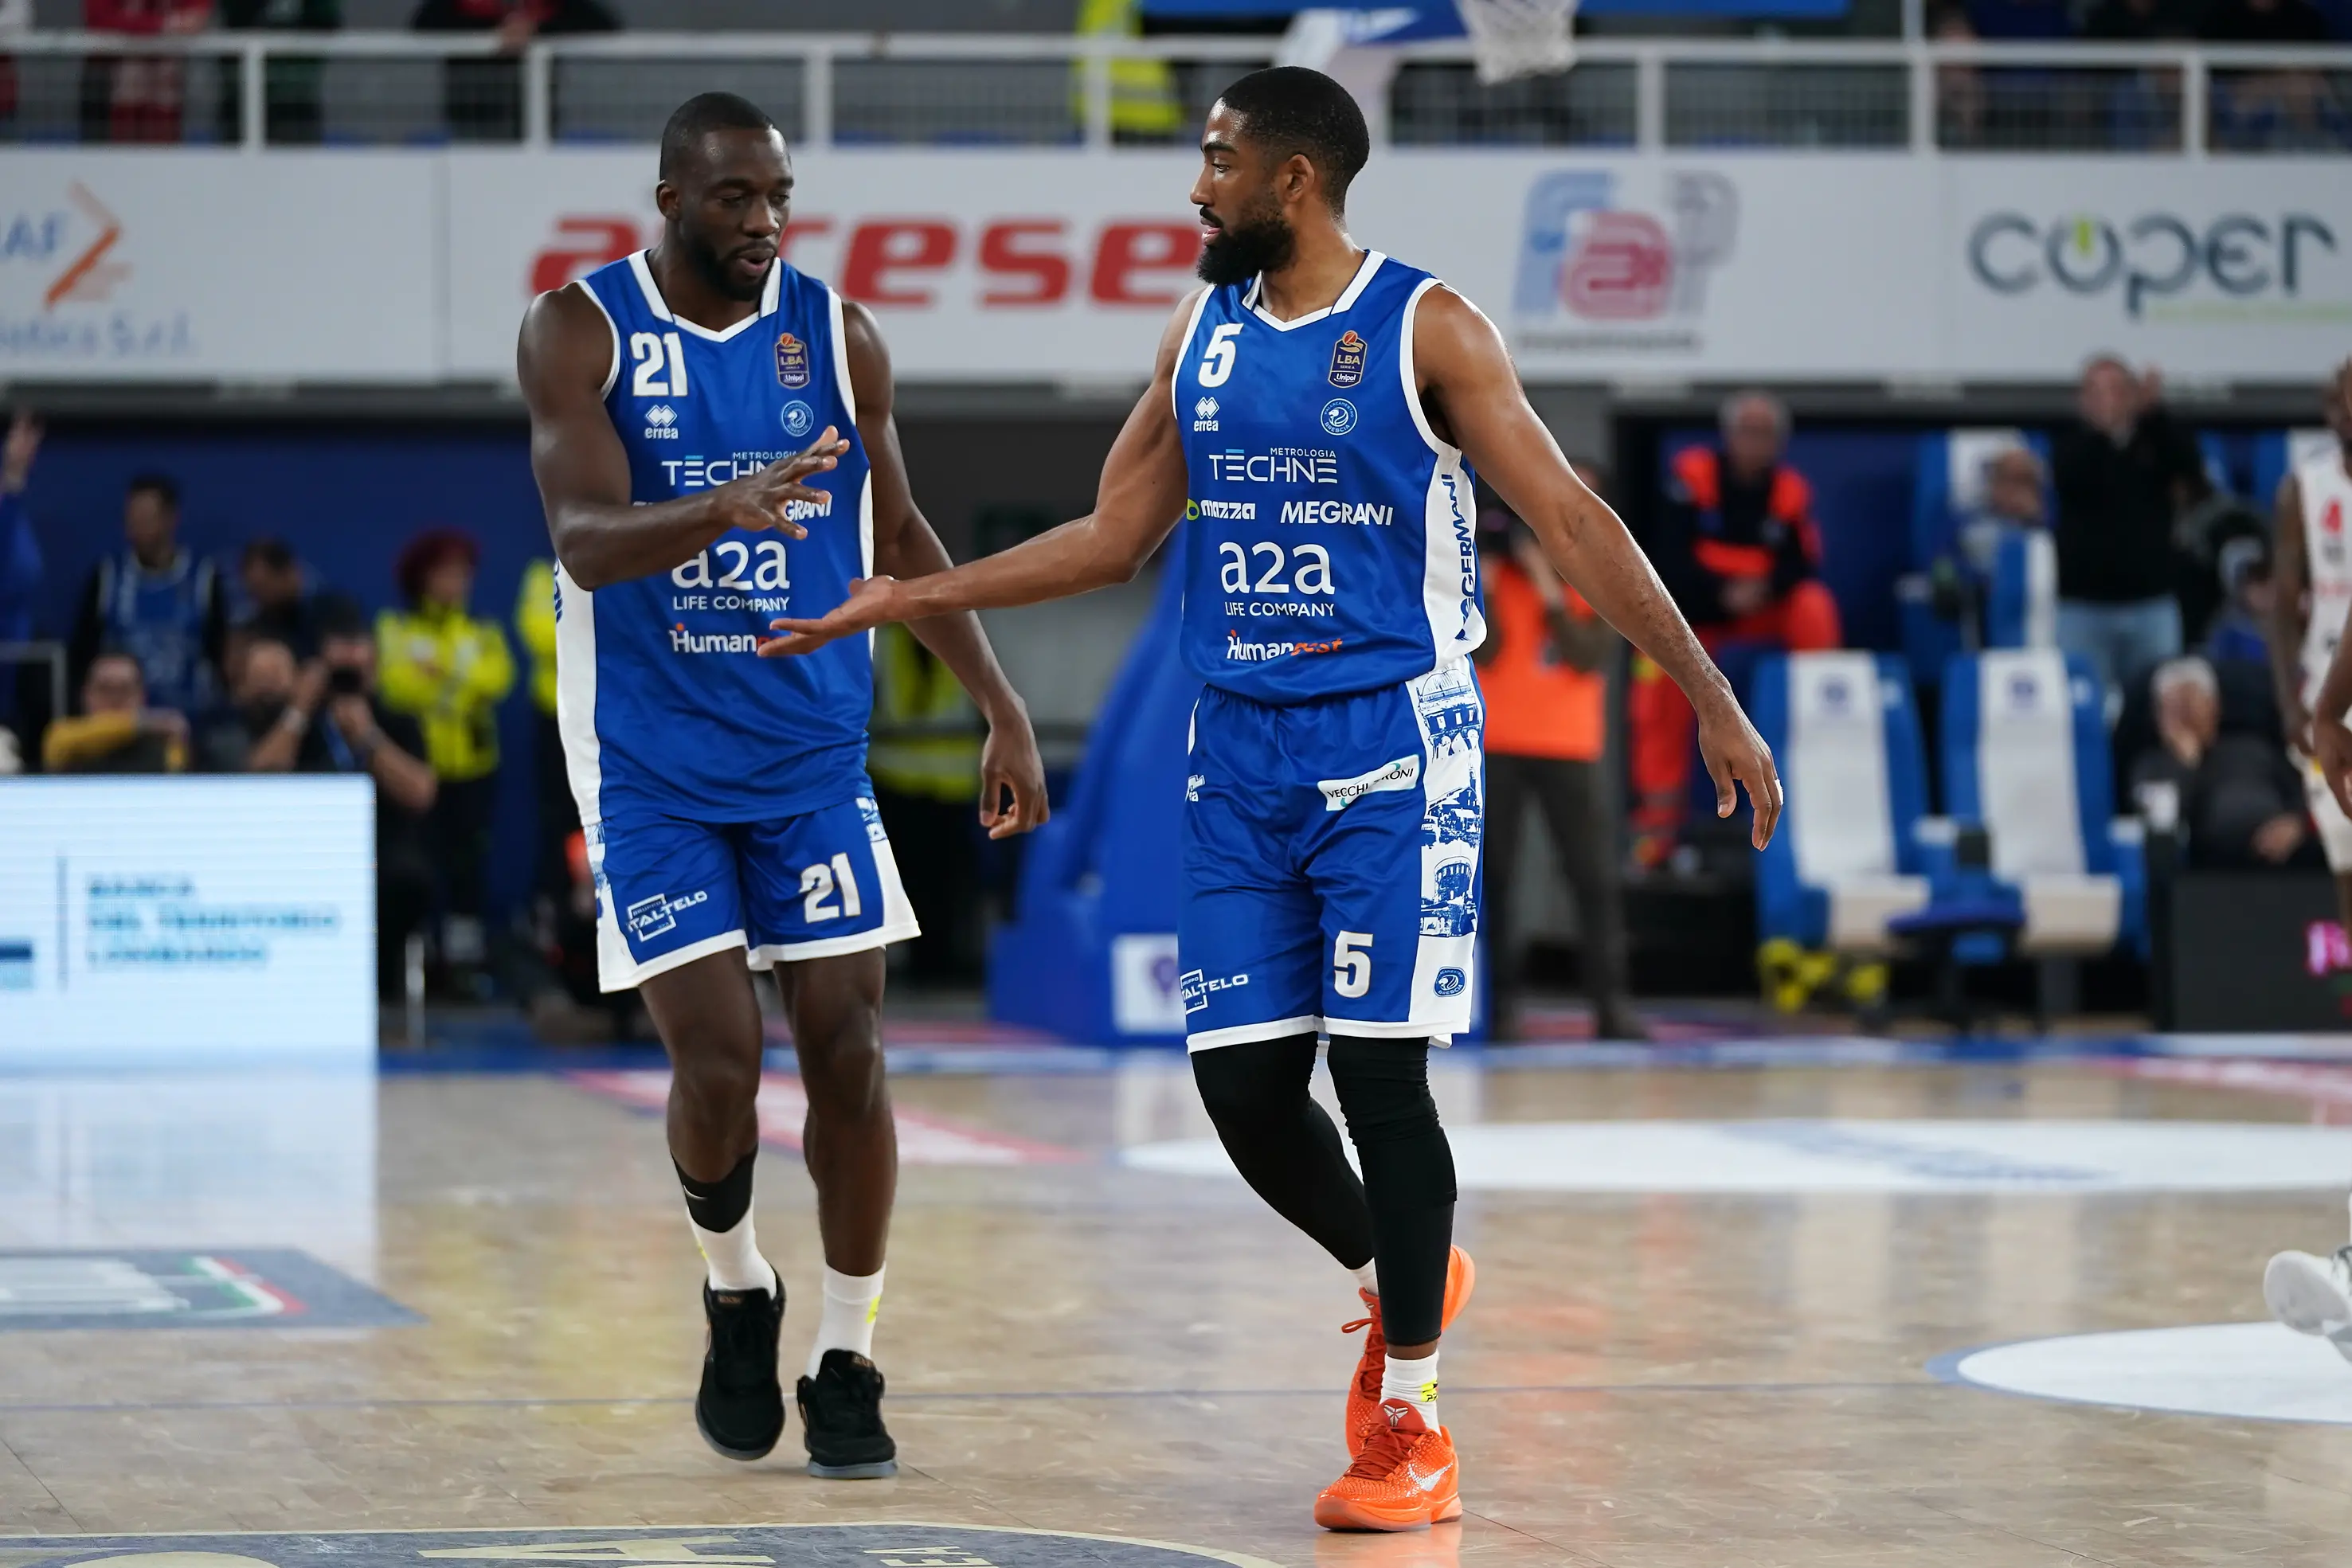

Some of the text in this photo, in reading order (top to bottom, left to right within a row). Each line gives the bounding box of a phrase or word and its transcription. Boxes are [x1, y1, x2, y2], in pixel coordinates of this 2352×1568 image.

[780, 355, 804, 366] LBA
[1198, 323, 1244, 388] 5
[1336, 354, 1360, 365] LBA
[628, 331, 688, 397] 21
[1336, 373, 1356, 382] Unipol
[644, 426, 679, 440] errea
[1194, 420, 1219, 432] errea
[1270, 448, 1336, 459] METROLOGIA
[1280, 500, 1394, 526] MEGRANI
[1219, 542, 1336, 595] a2a
[672, 596, 791, 613] LIFE COMPANY
[1224, 601, 1335, 617] LIFE COMPANY
[798, 852, 862, 924] 21
[1333, 930, 1373, 999] 5
